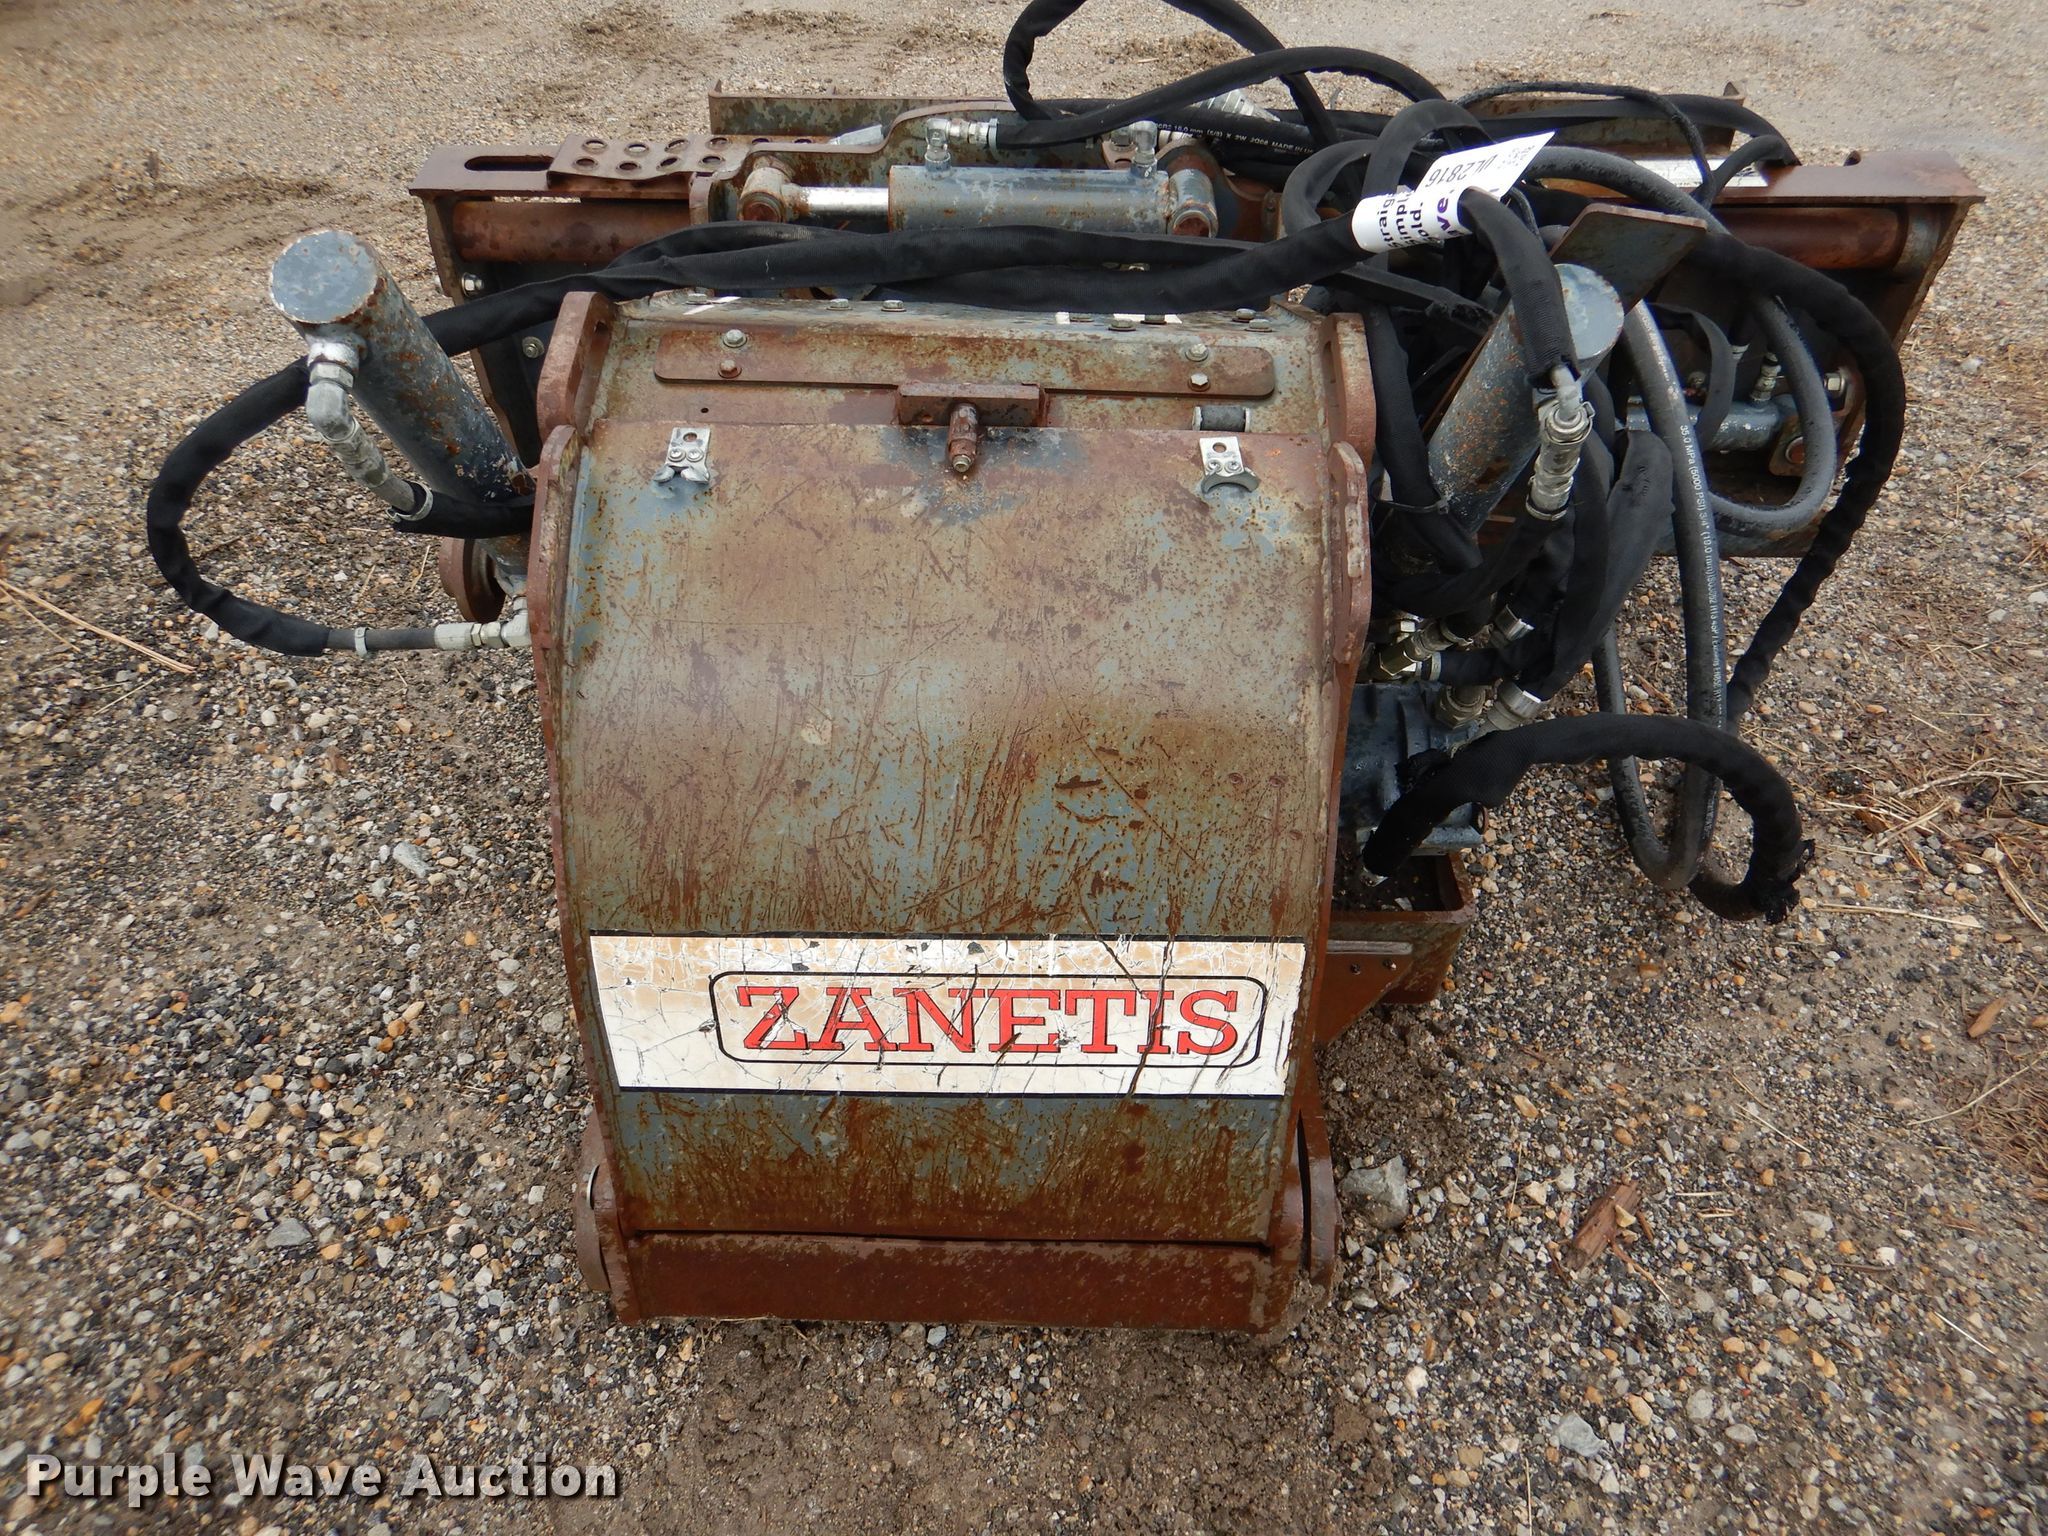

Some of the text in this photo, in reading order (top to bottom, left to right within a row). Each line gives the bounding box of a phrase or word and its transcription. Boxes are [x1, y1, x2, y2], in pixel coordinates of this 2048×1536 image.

[1377, 193, 1398, 248] Straig
[1680, 424, 1692, 444] 35.0
[1684, 445, 1697, 465] MPa
[1688, 466, 1702, 491] (5000
[736, 986, 1239, 1055] ZANETIS
